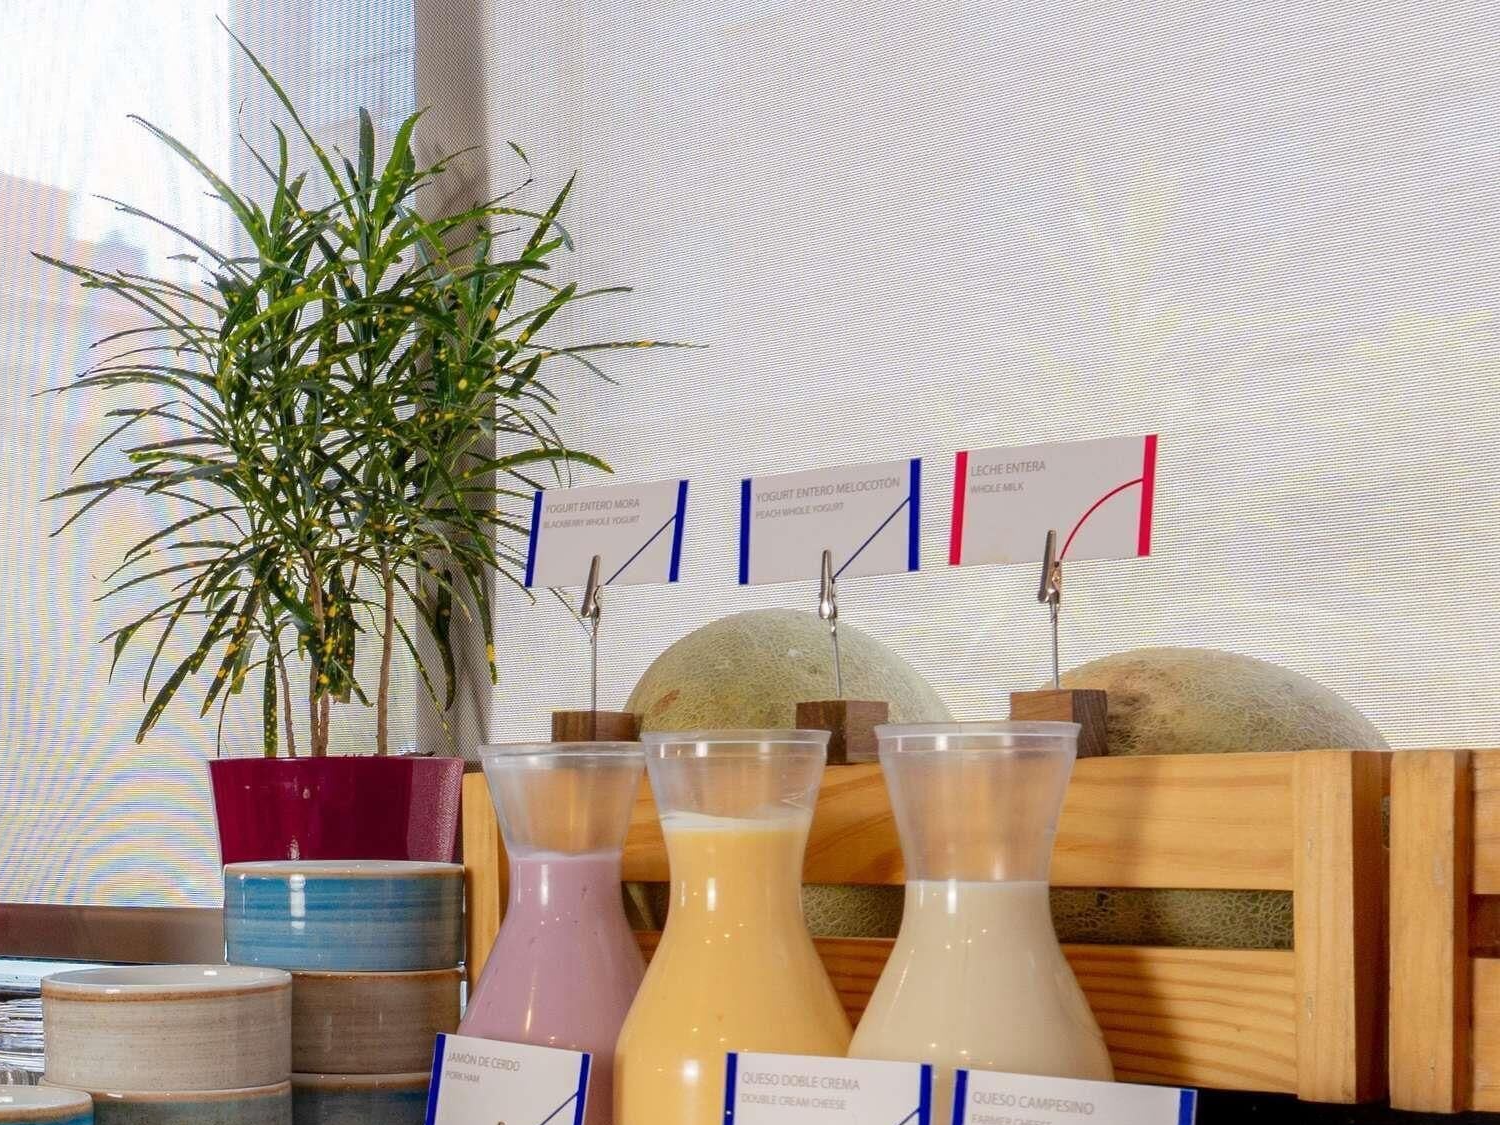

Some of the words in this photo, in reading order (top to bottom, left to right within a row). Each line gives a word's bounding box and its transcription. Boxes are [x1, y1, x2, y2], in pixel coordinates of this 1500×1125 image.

[971, 464, 1004, 477] LECHE
[1005, 461, 1046, 474] ENTERA
[756, 490, 794, 503] YOGURT
[796, 485, 835, 498] ENTERO
[971, 484, 1002, 494] WHOLE
[1003, 482, 1024, 492] MILK
[545, 503, 578, 514] YOGURT
[580, 500, 612, 512] ENTERO
[615, 499, 640, 509] MORA
[756, 508, 781, 519] PEACH
[783, 506, 810, 517] WHOLE
[813, 503, 844, 513] YOGURT
[585, 517, 612, 526] WHOLE
[613, 515, 640, 524] YOGURT
[478, 1056, 490, 1067] DE
[491, 1058, 520, 1071] CERDO
[445, 1070, 464, 1080] PORK
[464, 1072, 480, 1083] HAM
[742, 1072, 780, 1086] QUESO
[782, 1074, 819, 1088] DOBLE
[820, 1076, 860, 1091] CREMA
[741, 1093, 777, 1105] DOUBLE
[779, 1096, 812, 1108] CREAM
[813, 1098, 846, 1111] CHEESE
[973, 1091, 1016, 1107] QUESO
[1018, 1095, 1095, 1116] CAMPESINO
